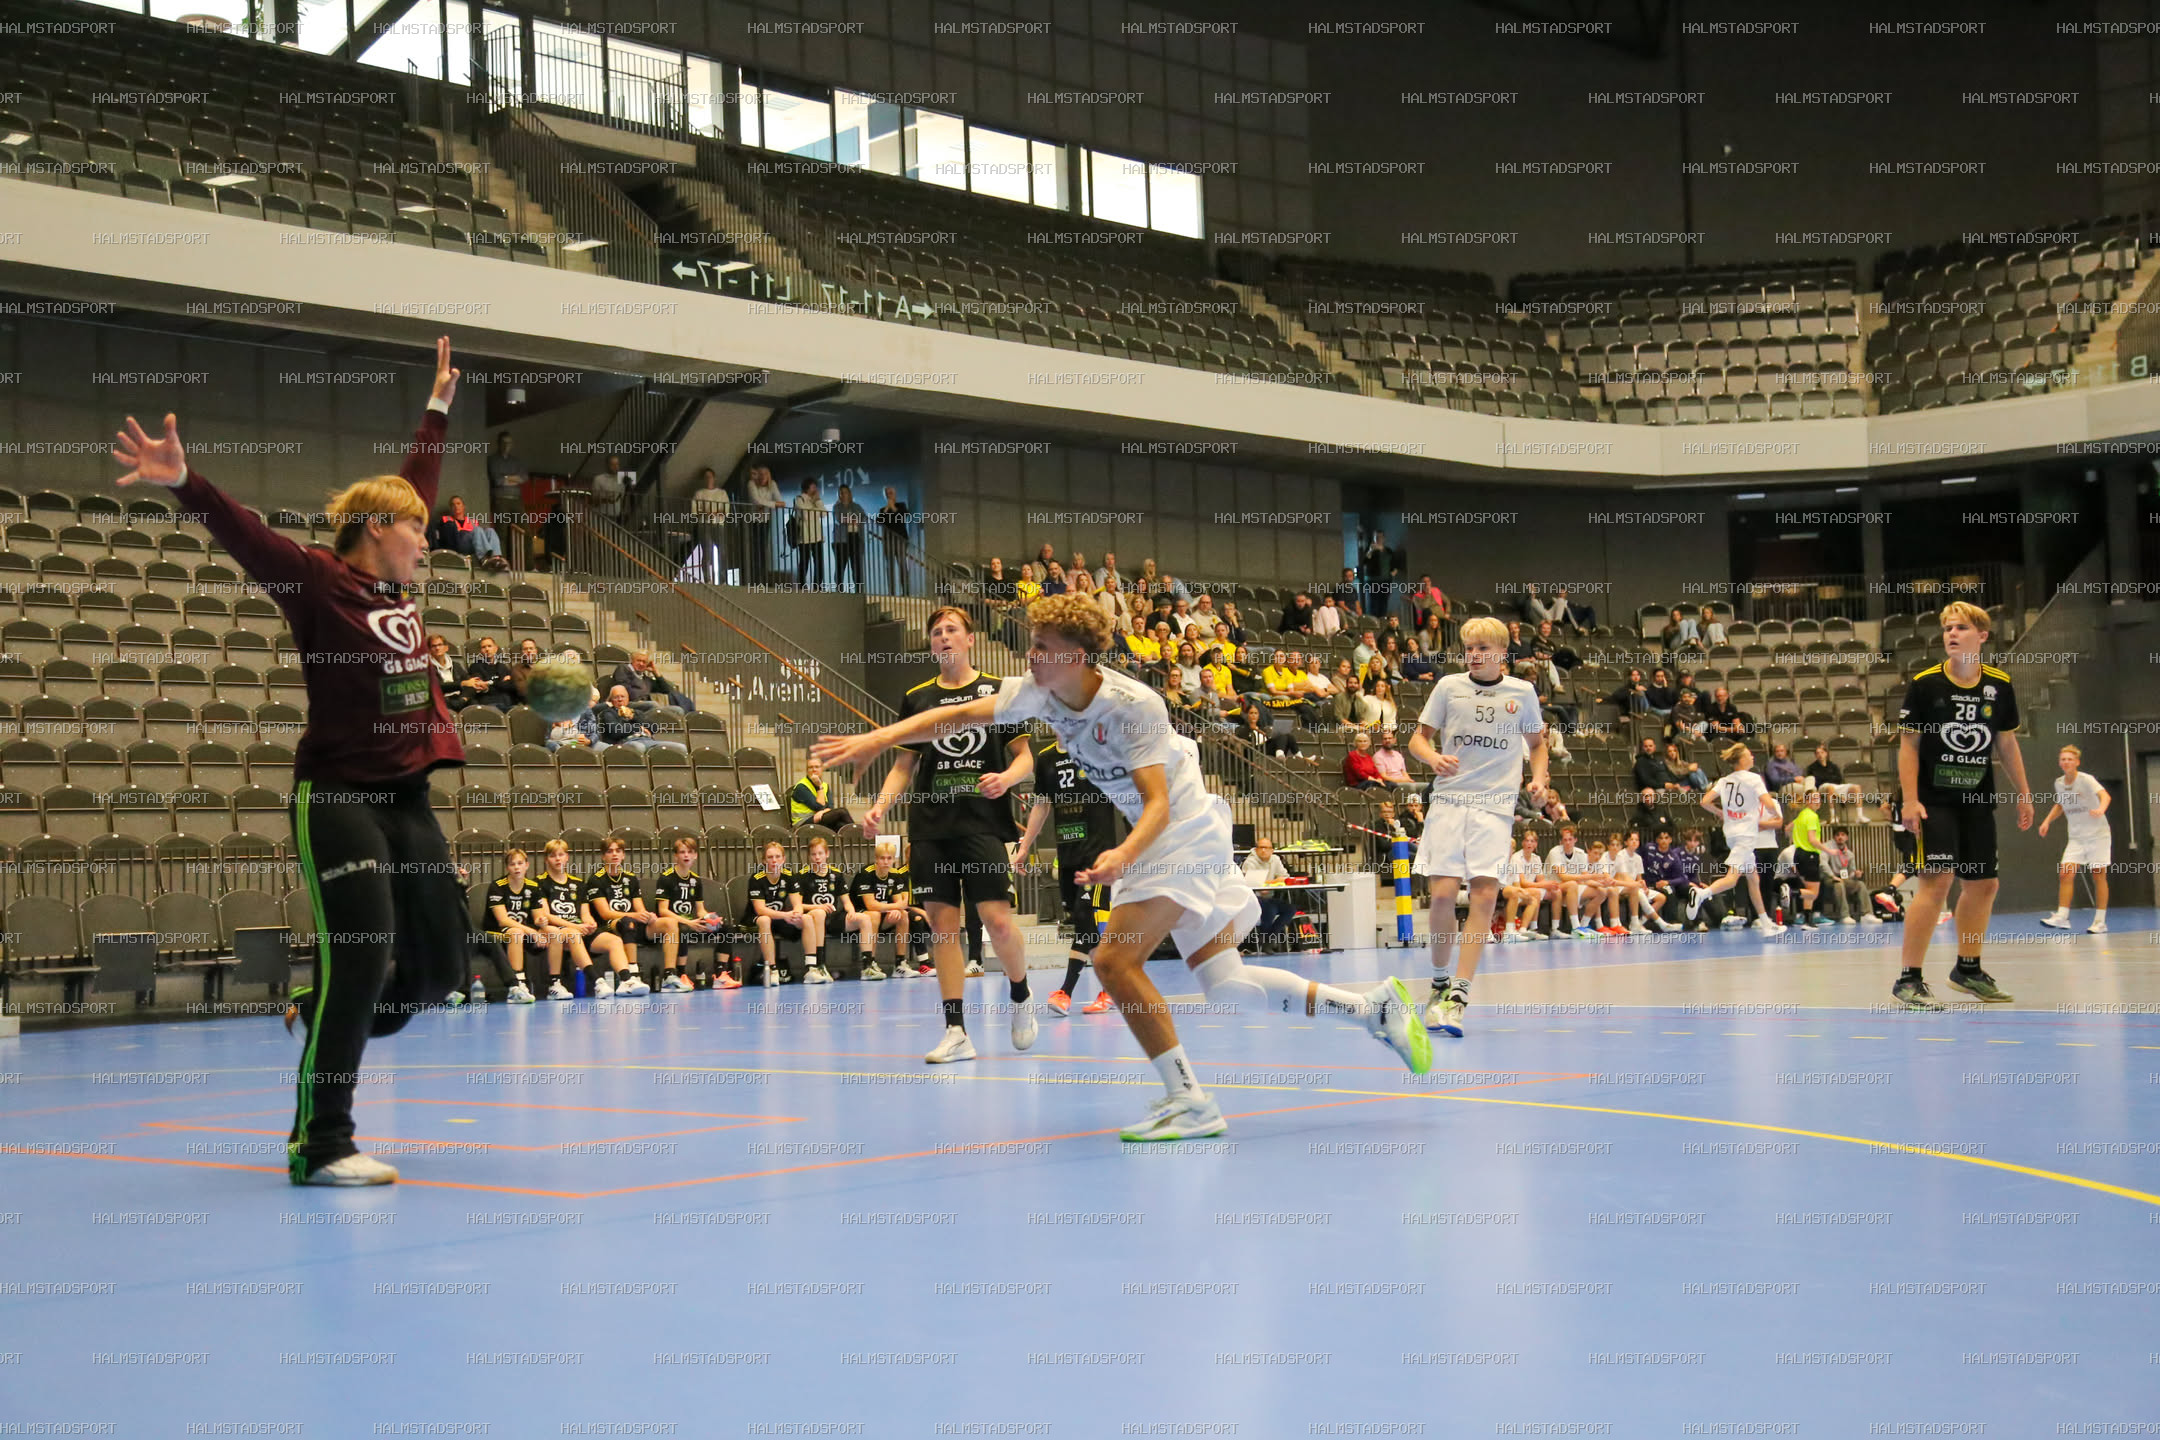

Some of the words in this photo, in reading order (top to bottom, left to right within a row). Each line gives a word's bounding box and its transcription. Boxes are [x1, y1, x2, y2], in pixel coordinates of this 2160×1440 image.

[748, 675, 821, 703] Arena
[1950, 694, 1981, 703] stadium
[940, 694, 973, 705] stadium
[1474, 704, 1496, 724] 53
[1955, 702, 1977, 721] 28
[937, 760, 951, 770] GB
[953, 759, 983, 770] GLACE
[1940, 753, 1955, 763] GB
[1956, 754, 1988, 765] GLACE
[1057, 768, 1075, 789] 22
[1725, 781, 1745, 808] 76
